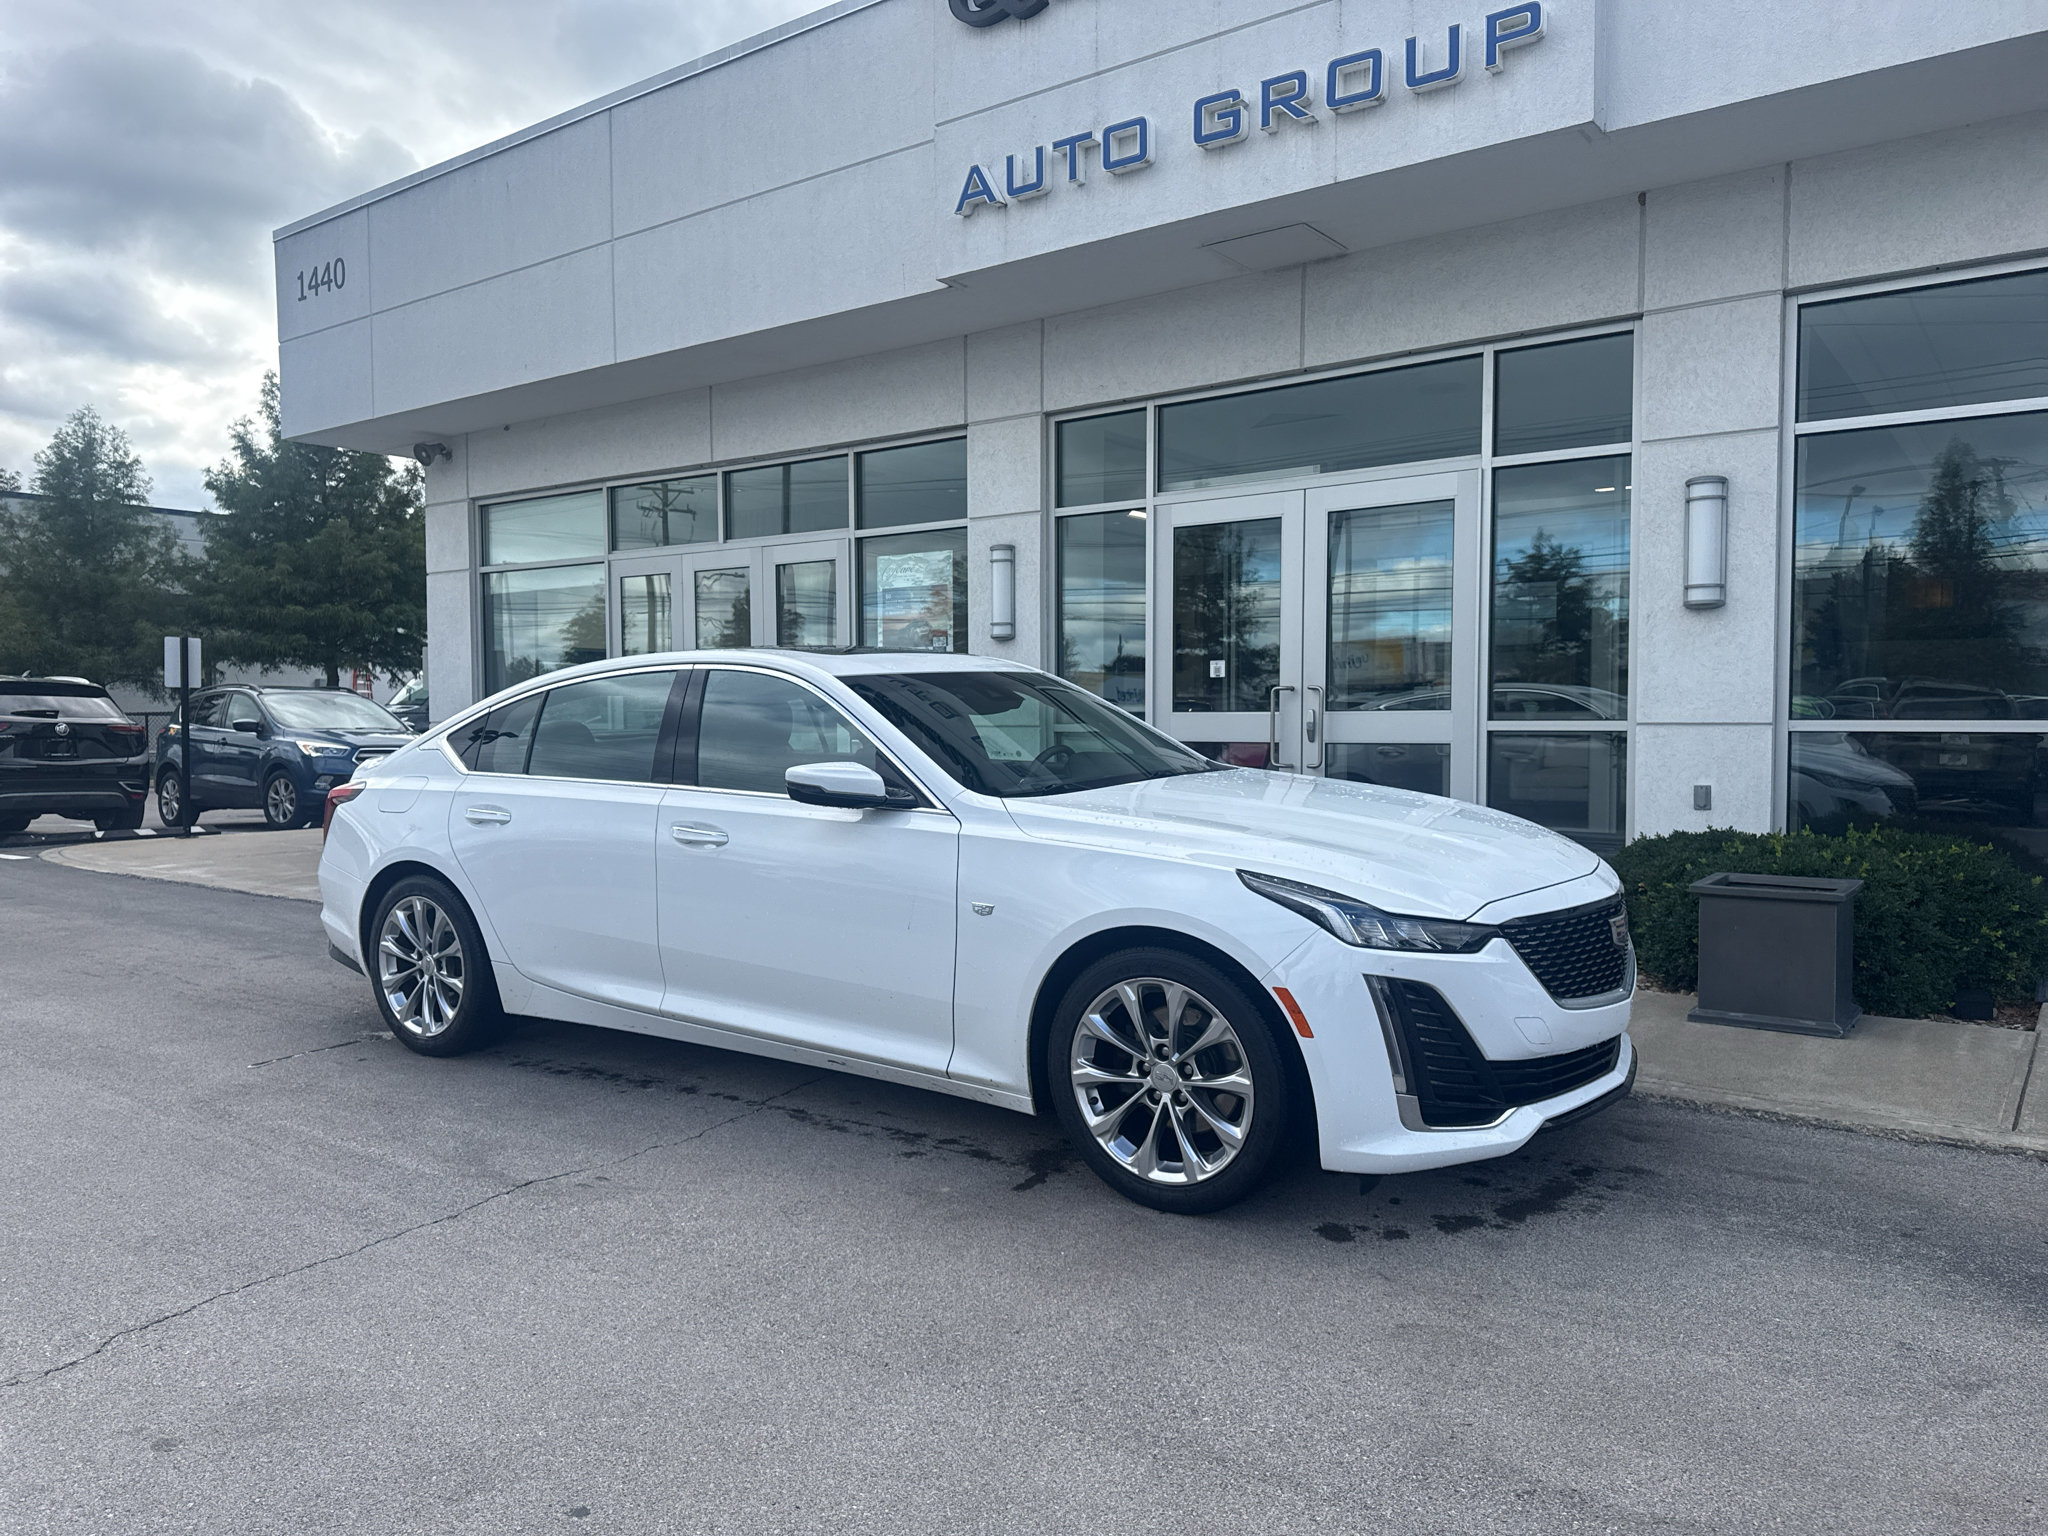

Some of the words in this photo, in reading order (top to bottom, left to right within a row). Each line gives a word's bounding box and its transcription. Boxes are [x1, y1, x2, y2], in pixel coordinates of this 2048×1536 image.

[954, 115, 1154, 217] AUTO
[1193, 0, 1546, 149] GROUP
[297, 257, 346, 302] 1440
